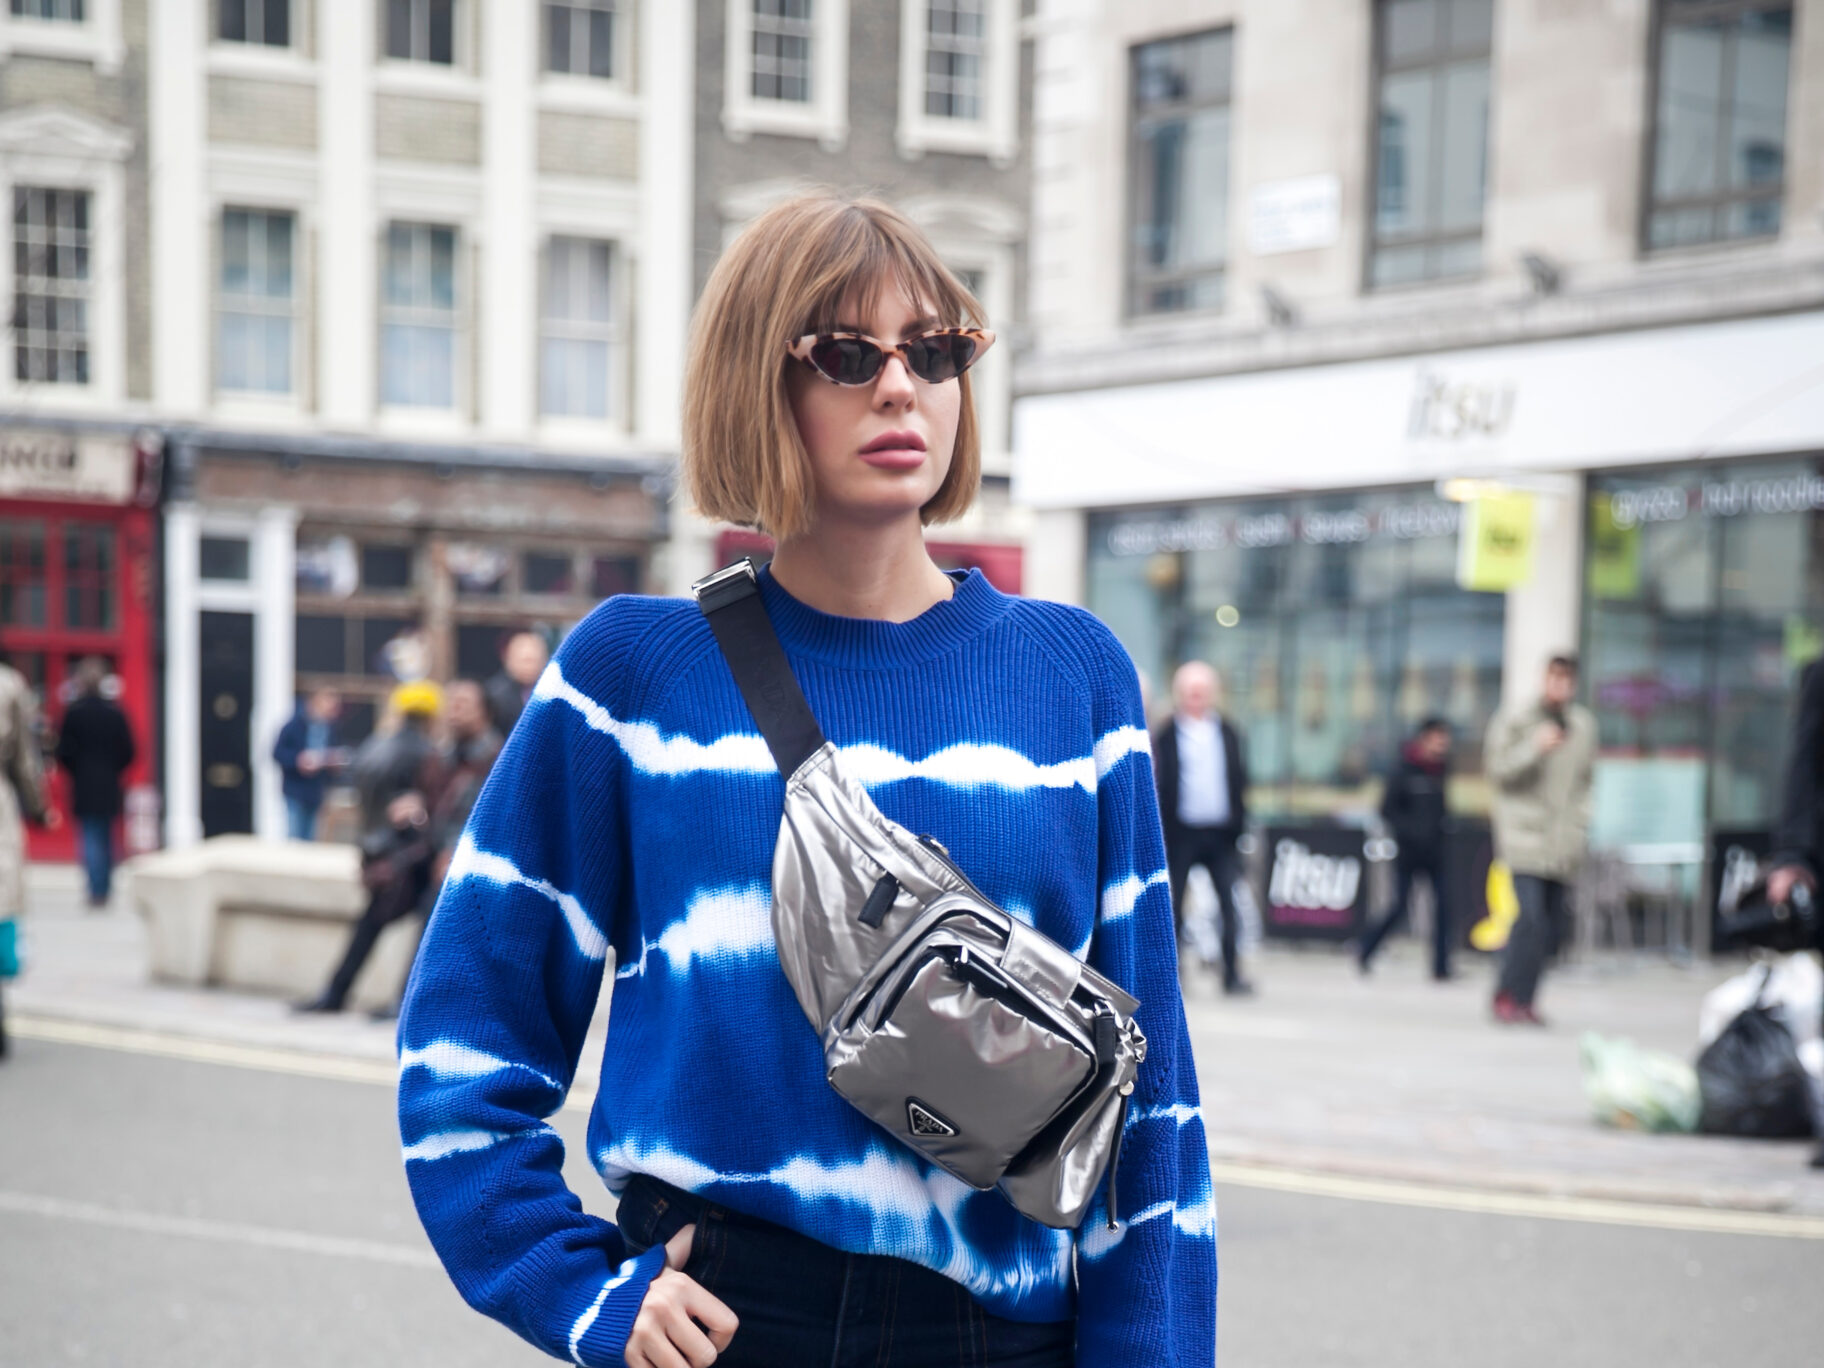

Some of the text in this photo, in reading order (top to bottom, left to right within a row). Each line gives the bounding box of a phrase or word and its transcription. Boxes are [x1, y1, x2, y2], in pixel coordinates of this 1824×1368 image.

[1406, 365, 1519, 440] itsu
[1269, 838, 1361, 911] itsu
[915, 1111, 943, 1132] PRADA
